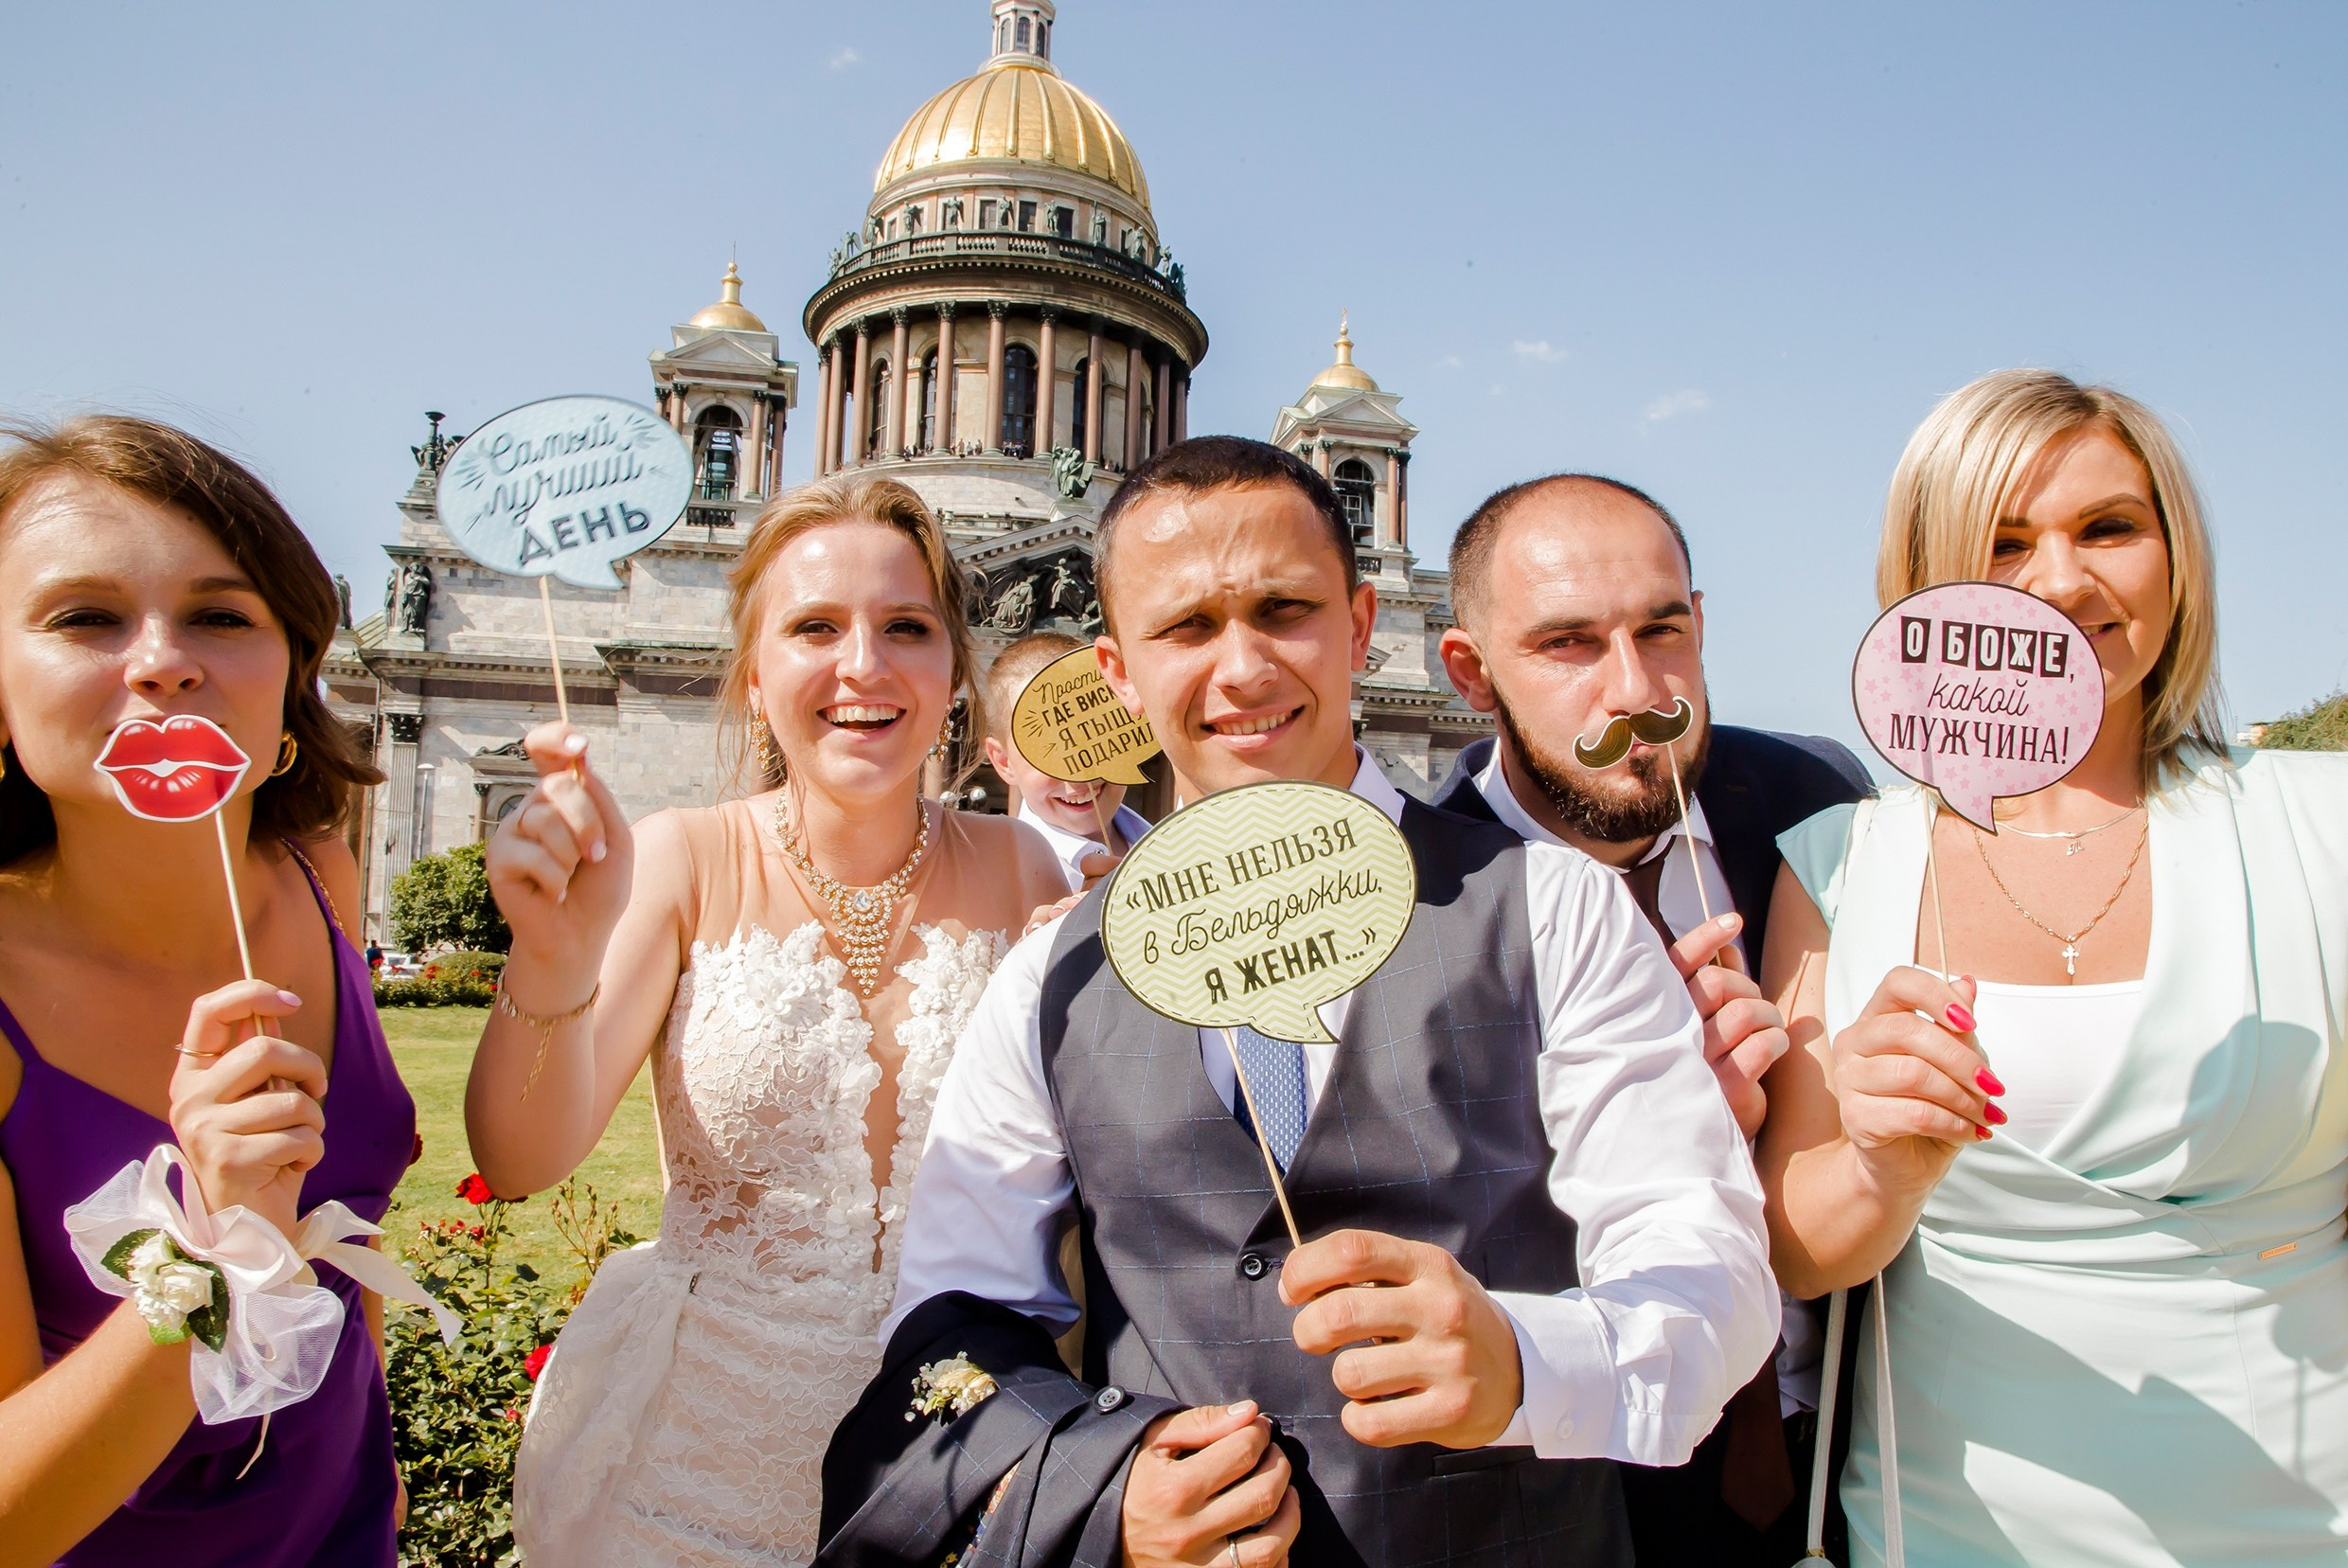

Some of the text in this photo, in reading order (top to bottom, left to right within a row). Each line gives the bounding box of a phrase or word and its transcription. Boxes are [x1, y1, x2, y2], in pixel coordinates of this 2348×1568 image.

[518, 501, 651, 567] ДЕНЬ
[1904, 618, 1929, 661] О
[1041, 702, 1075, 727] ГДЕ
[1927, 672, 2030, 717] какой
[1058, 727, 1077, 752] Я
[1888, 713, 2070, 764] МУЖЧИНА!
[1126, 818, 1358, 914] «МНЕ НЕЛЬЗЯ
[1204, 967, 1229, 1005] Я
